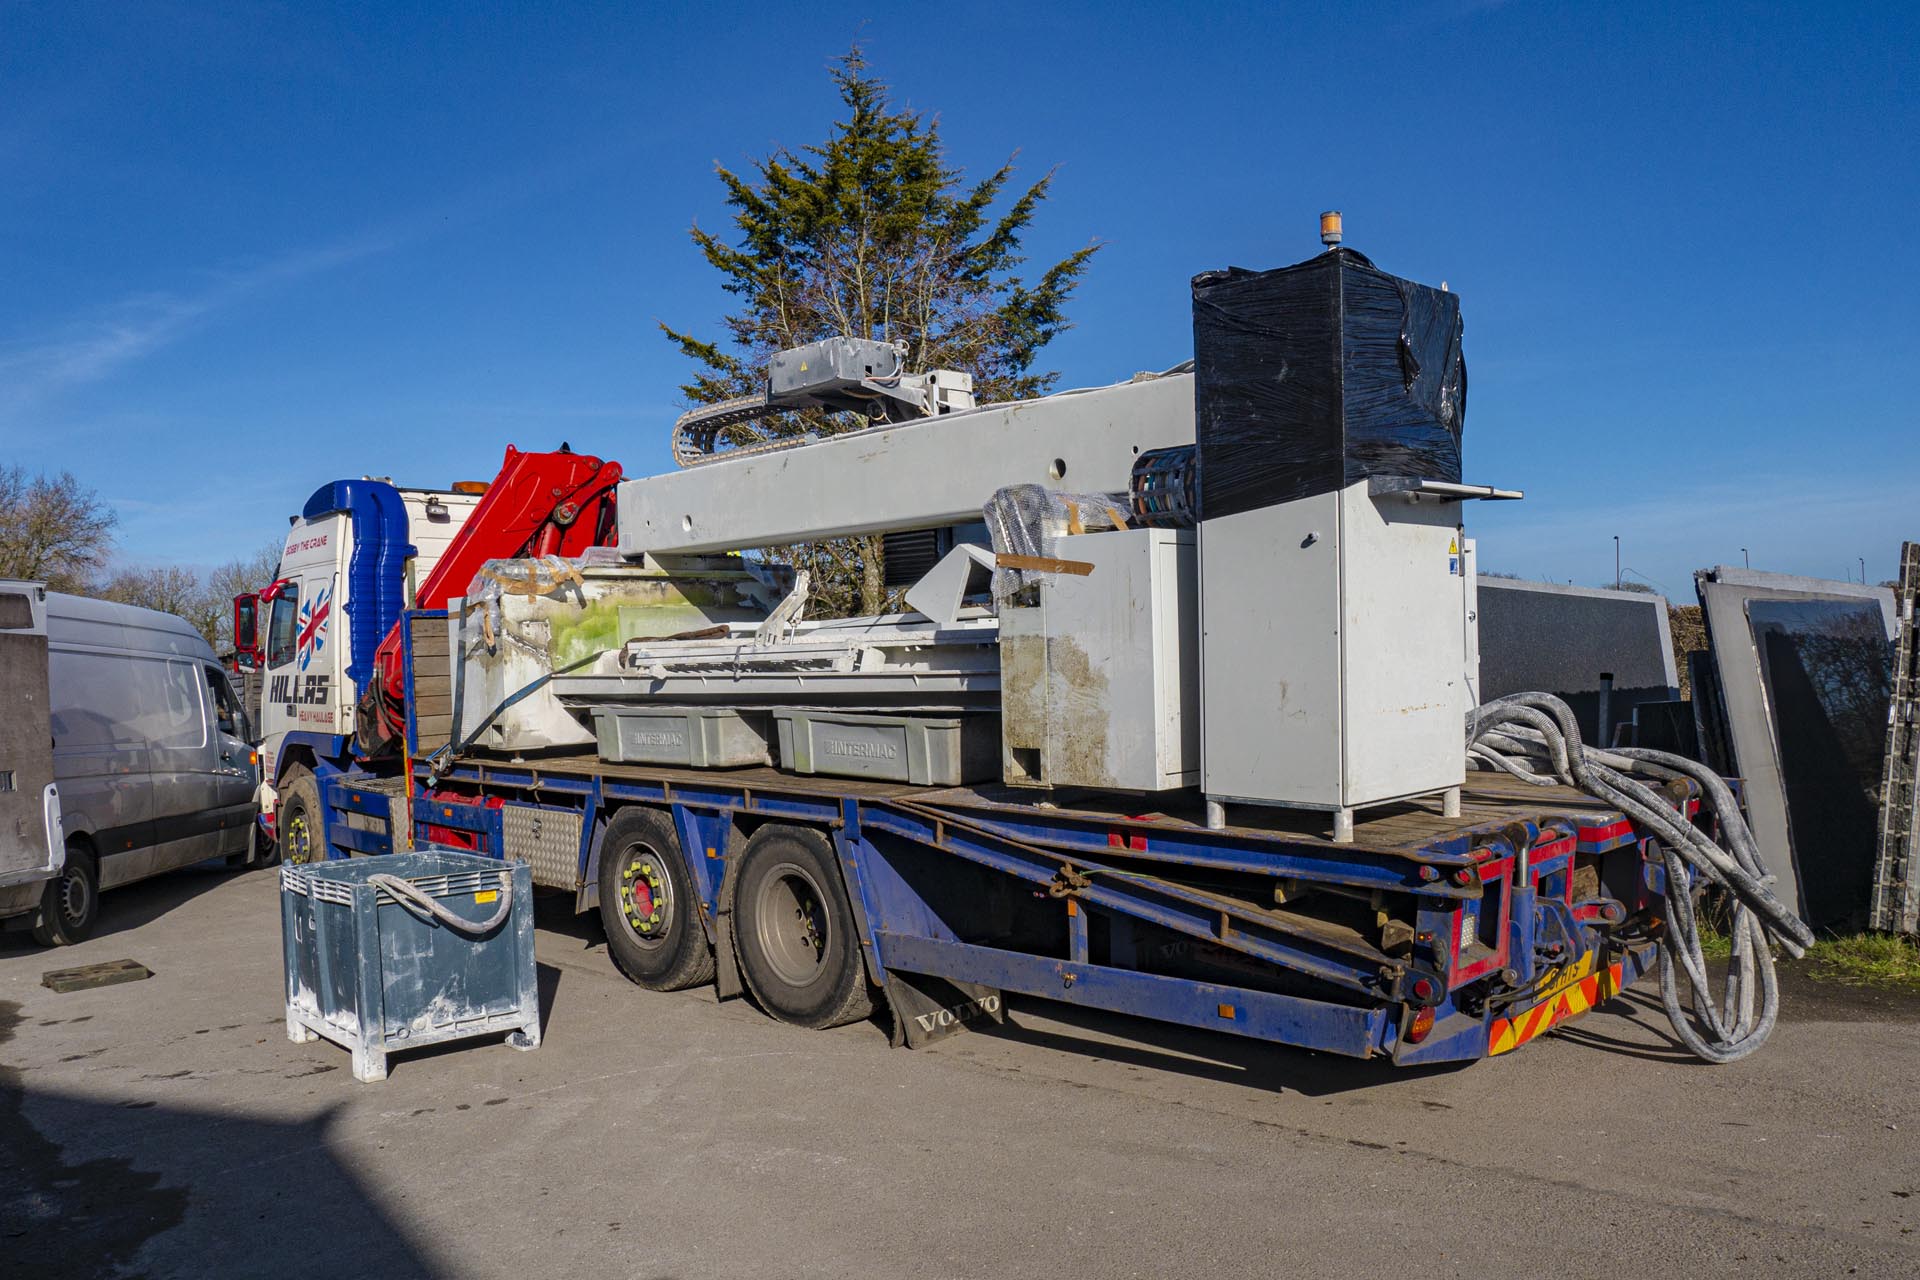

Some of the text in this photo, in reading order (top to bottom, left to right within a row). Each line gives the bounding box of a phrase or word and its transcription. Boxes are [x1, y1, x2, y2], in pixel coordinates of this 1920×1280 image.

[310, 535, 328, 549] CRANE
[269, 674, 330, 705] HILLAS
[635, 731, 683, 747] INTERMAC
[833, 740, 897, 760] INTERMAC
